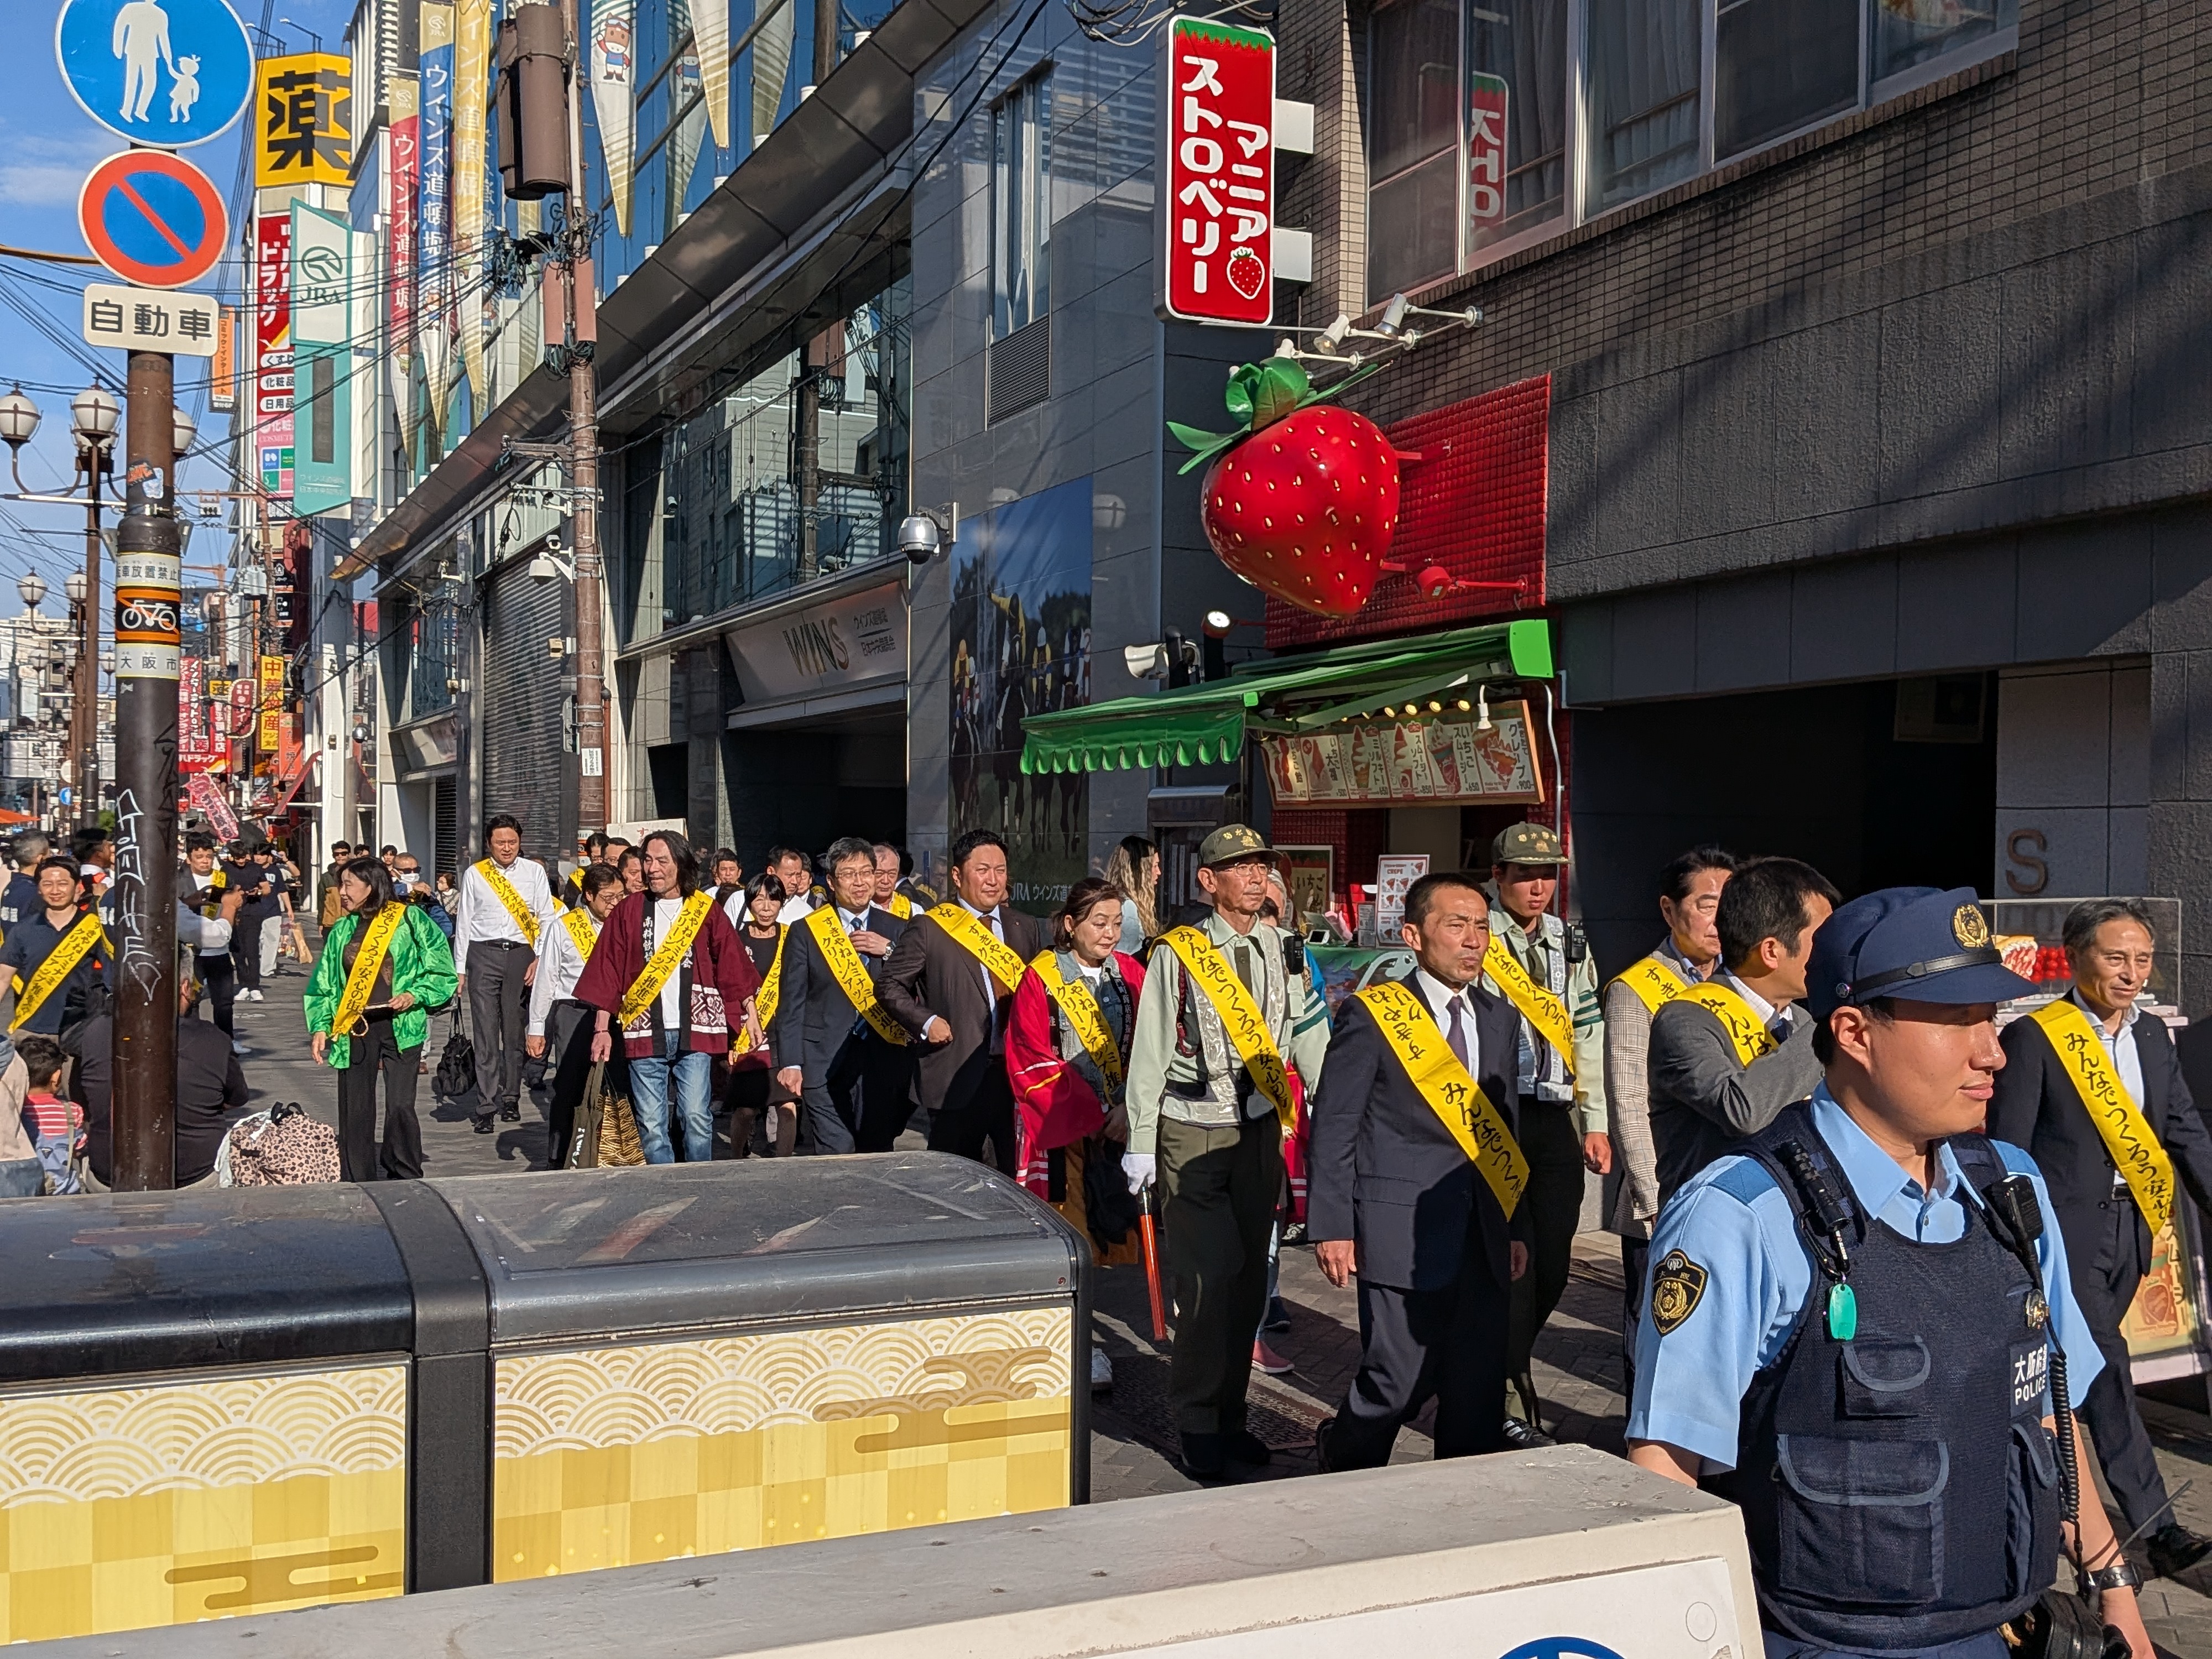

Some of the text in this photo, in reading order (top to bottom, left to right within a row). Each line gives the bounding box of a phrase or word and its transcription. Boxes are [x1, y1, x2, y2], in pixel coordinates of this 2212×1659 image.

[455, 1, 484, 197] インズ道頓堀
[267, 70, 352, 173] 薬
[1180, 55, 1227, 294] ストロベリー
[1227, 120, 1269, 242] マニア
[300, 286, 342, 305] JRA
[91, 299, 212, 341] 自動車
[267, 354, 294, 366] くすり
[265, 377, 294, 388] 化粧品
[265, 398, 294, 409] 日用品
[120, 656, 177, 670] 大阪市
[782, 617, 849, 676] WINS
[1329, 738, 1340, 769] いちご
[1368, 752, 1379, 785] ソフト
[1372, 739, 1385, 785] ミルキー
[1411, 748, 1422, 780] ソフト
[1415, 735, 1428, 780] スムージー
[1453, 727, 1468, 784] スムージー
[1461, 727, 1474, 768] いちご
[1509, 724, 1525, 779] クレープ
[1297, 874, 1325, 891] いちご
[2006, 830, 2048, 895] S
[1010, 882, 1030, 901] JRA
[1033, 884, 1072, 902] ウインズ道
[659, 899, 708, 977] すきやねんミナミ
[822, 916, 874, 998] すきやねんミナミ
[968, 924, 1022, 975] すきやねん
[978, 947, 1017, 988] クリーン
[1366, 987, 1426, 1061] すきやね
[1439, 1082, 1523, 1199] みんなでつく
[2015, 1374, 2046, 1405] POLICE
